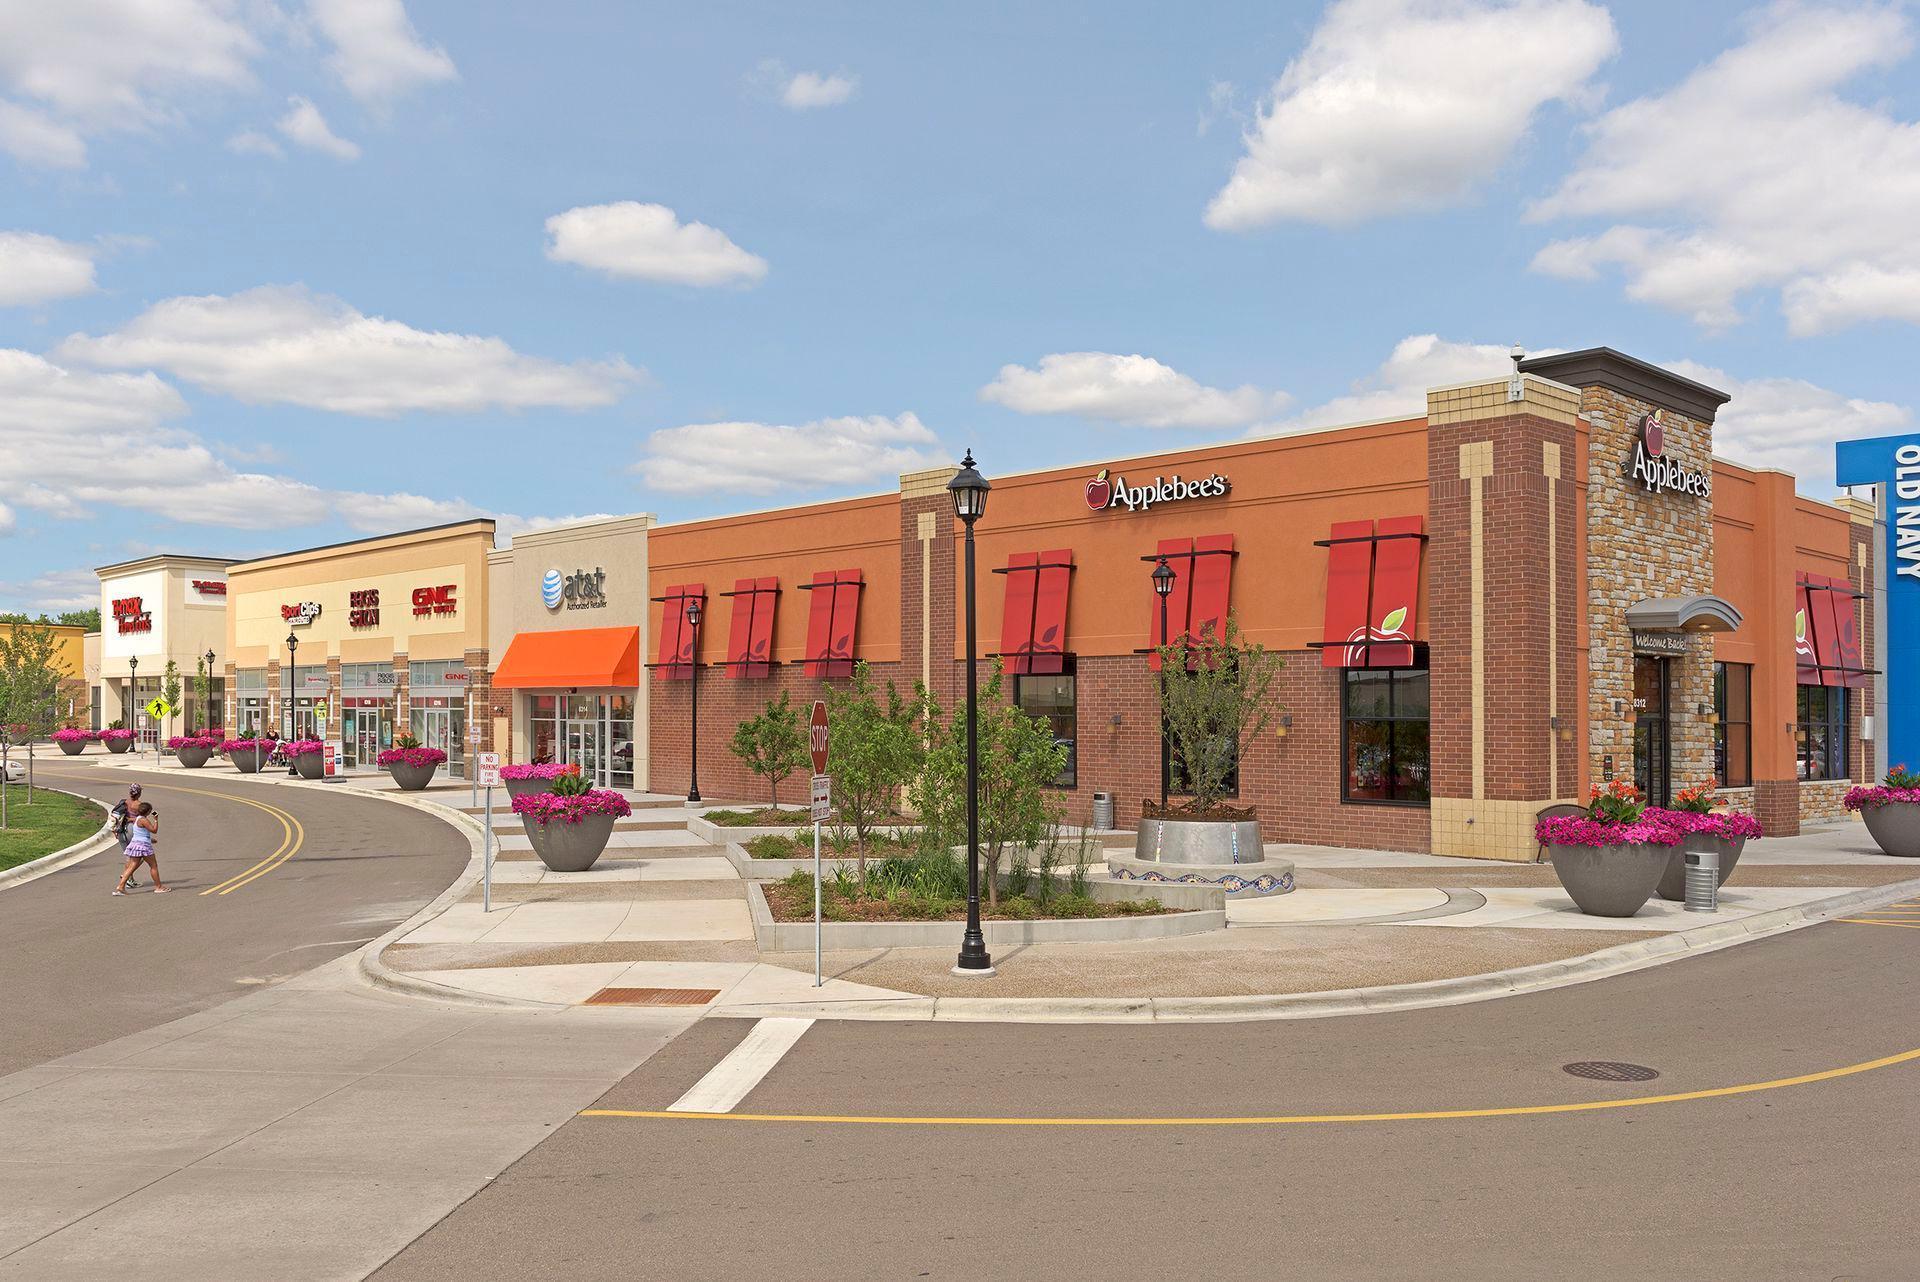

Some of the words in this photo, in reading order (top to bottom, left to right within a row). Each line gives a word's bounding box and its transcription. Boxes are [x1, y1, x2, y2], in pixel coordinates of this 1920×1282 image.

[1632, 440, 1709, 497] Applebee's
[1895, 444, 1920, 499] OLD
[1110, 474, 1225, 511] Applebee's
[1896, 505, 1920, 578] NAVY
[564, 567, 605, 599] at&t
[350, 589, 379, 608] REGIS
[412, 585, 457, 607] GNC
[567, 602, 589, 610] Authorized
[590, 600, 607, 608] Retailer
[349, 608, 379, 627] SALON
[1636, 634, 1666, 648] Welcome
[1634, 699, 1646, 707] 8312
[812, 725, 828, 752] STOP
